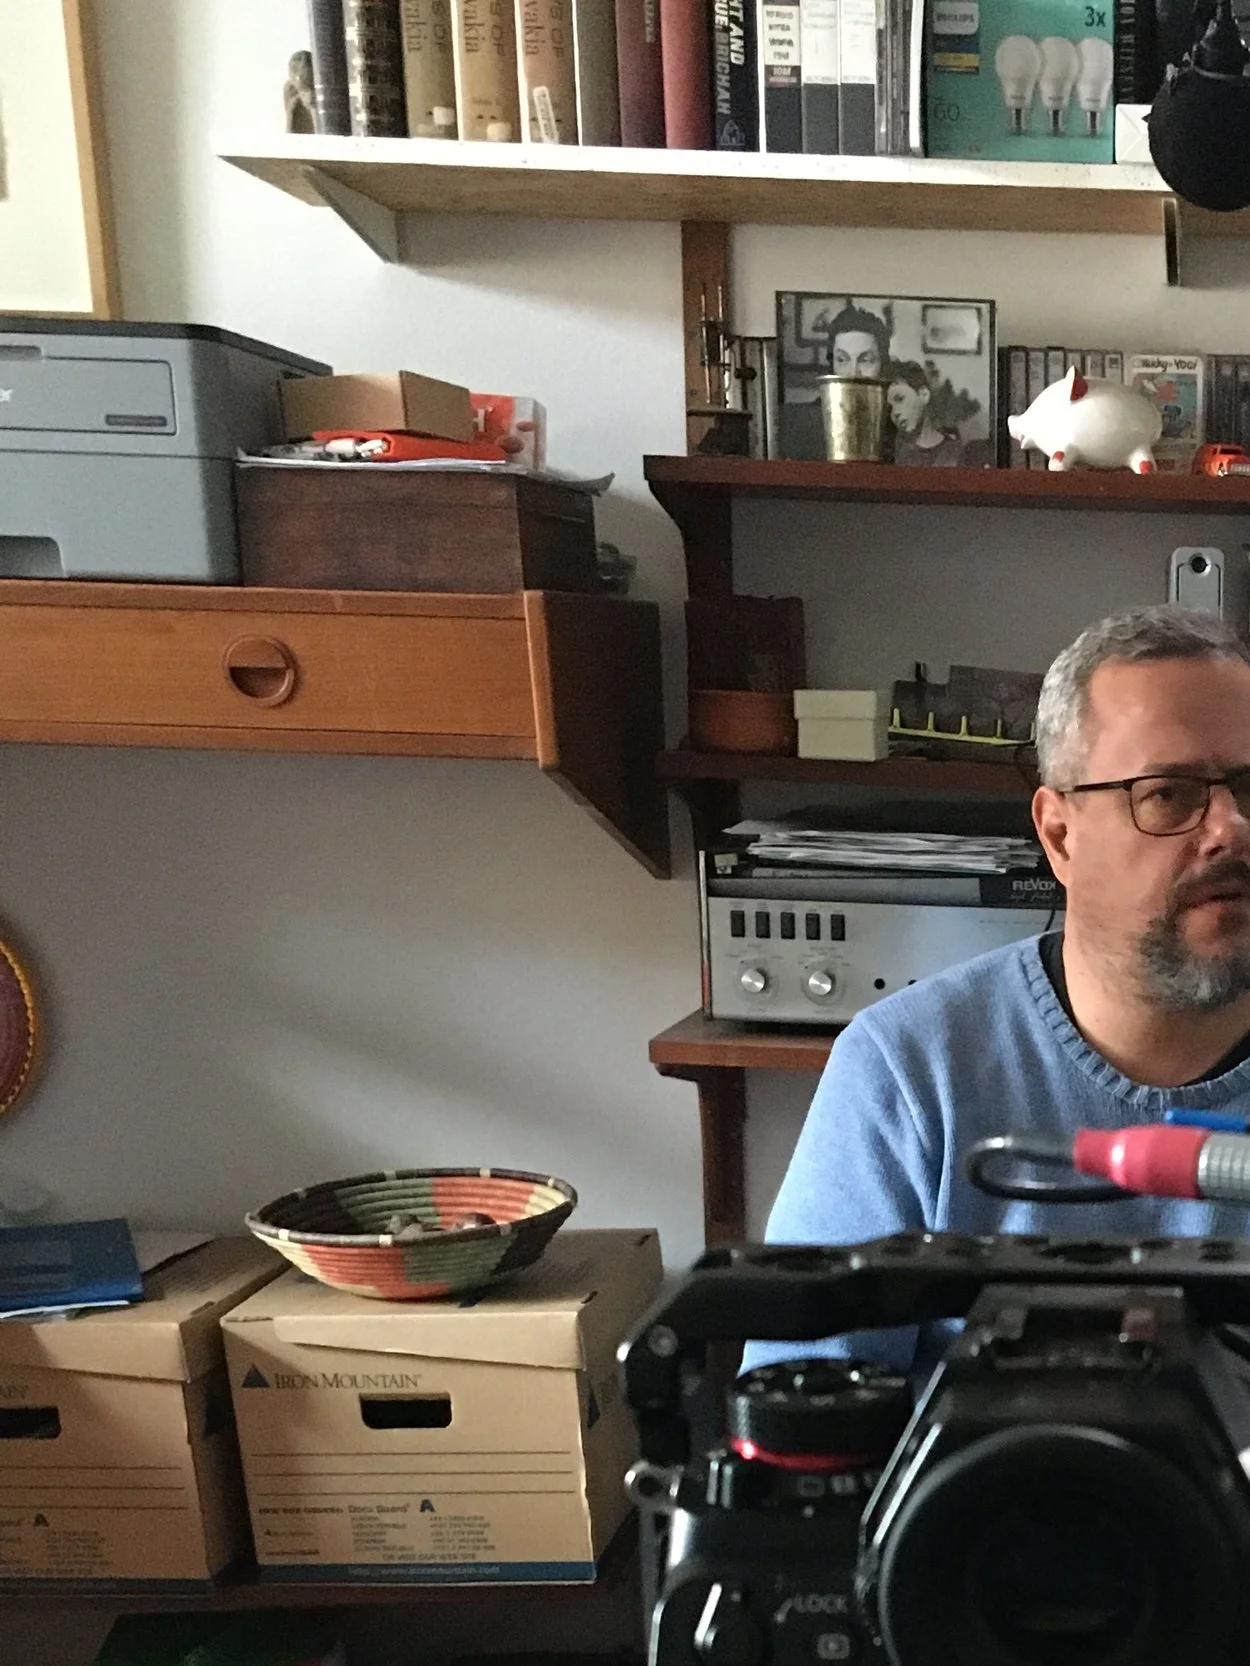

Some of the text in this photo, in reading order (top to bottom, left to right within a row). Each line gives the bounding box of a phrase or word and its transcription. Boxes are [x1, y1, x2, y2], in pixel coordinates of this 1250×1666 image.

[936, 13, 975, 23] PHILIPS
[1085, 6, 1106, 27] 3x
[730, 22, 745, 65] AND
[715, 32, 731, 114] BRICHAH
[274, 1372, 318, 1389] IRON
